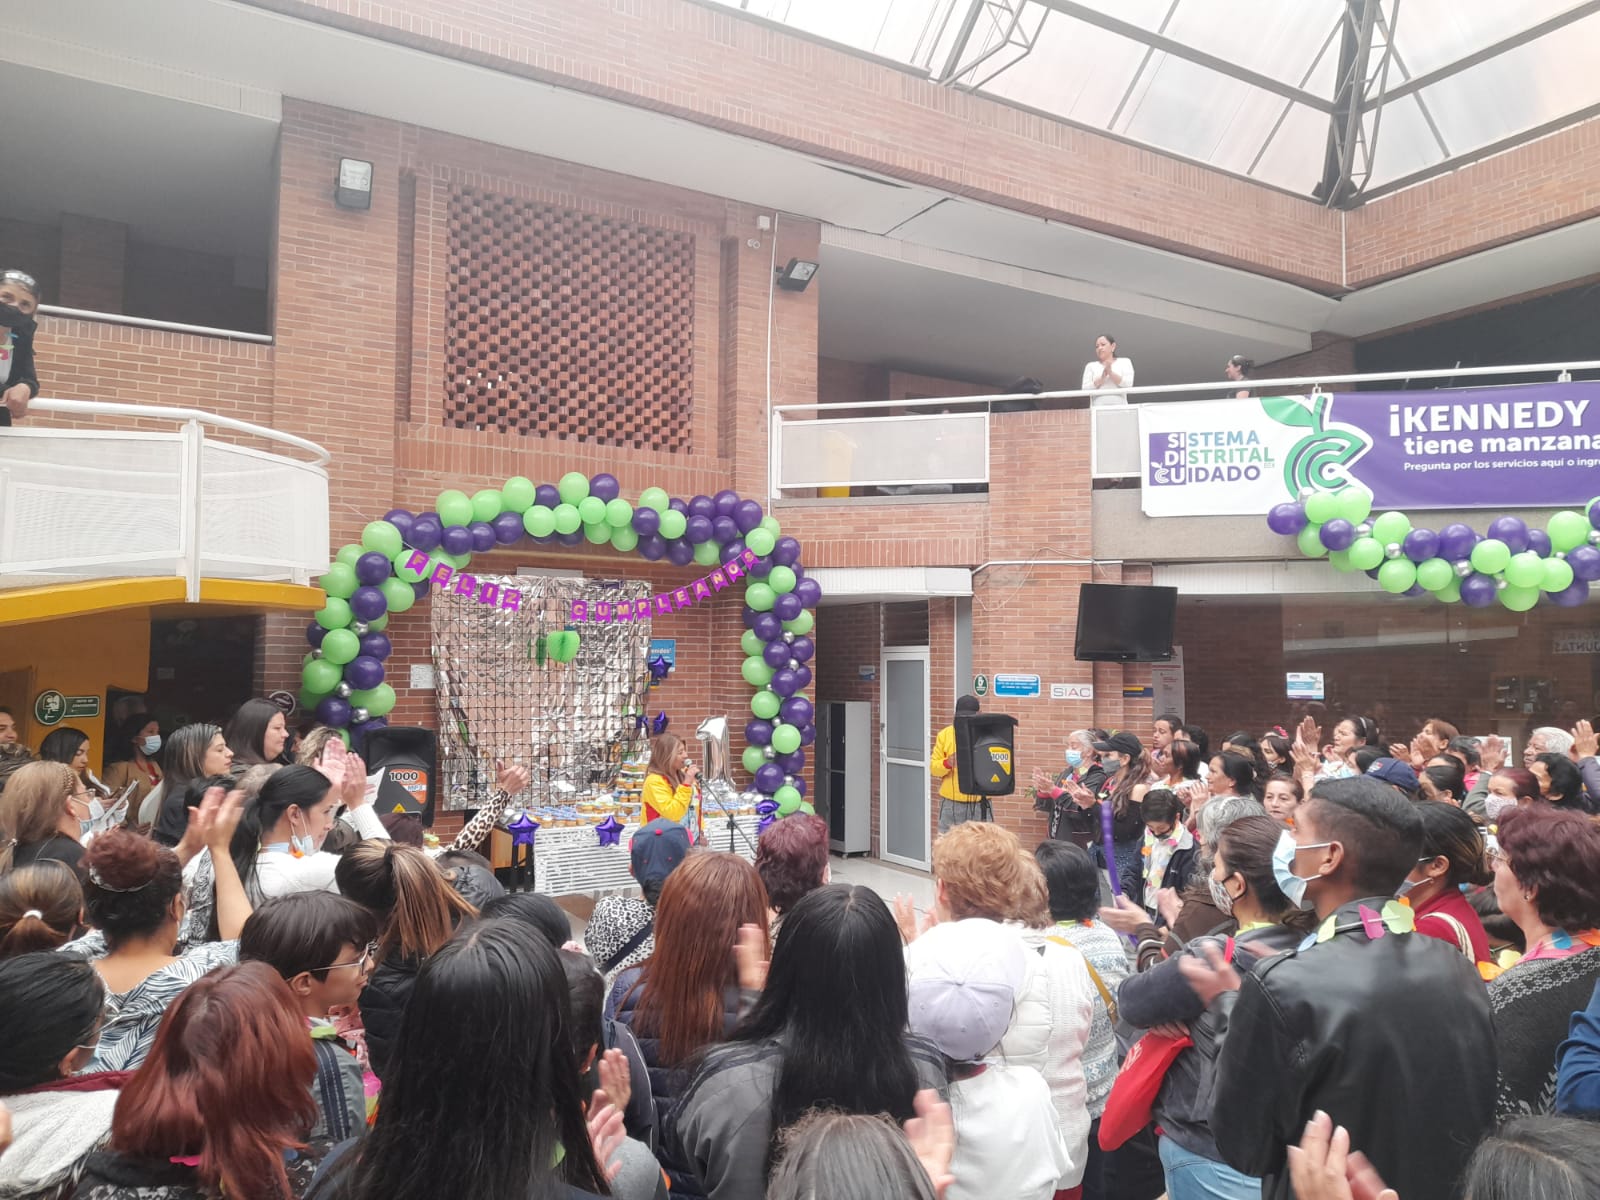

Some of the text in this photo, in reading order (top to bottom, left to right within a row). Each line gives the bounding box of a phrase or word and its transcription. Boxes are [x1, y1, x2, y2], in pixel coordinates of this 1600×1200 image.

[1167, 429, 1260, 449] SISTEMA
[1403, 435, 1474, 455] tiene
[1164, 446, 1275, 467] DISTRITAL
[1404, 459, 1451, 473] Pregunta
[1453, 460, 1472, 471] por
[1474, 459, 1490, 469] los
[1492, 458, 1539, 469] servicios
[1566, 458, 1575, 467] o
[1154, 464, 1261, 484] CUIDADO
[411, 553, 517, 605] FELIZ
[1053, 687, 1091, 698] SIAC
[991, 752, 1009, 761] 1000
[389, 771, 418, 781] 1000
